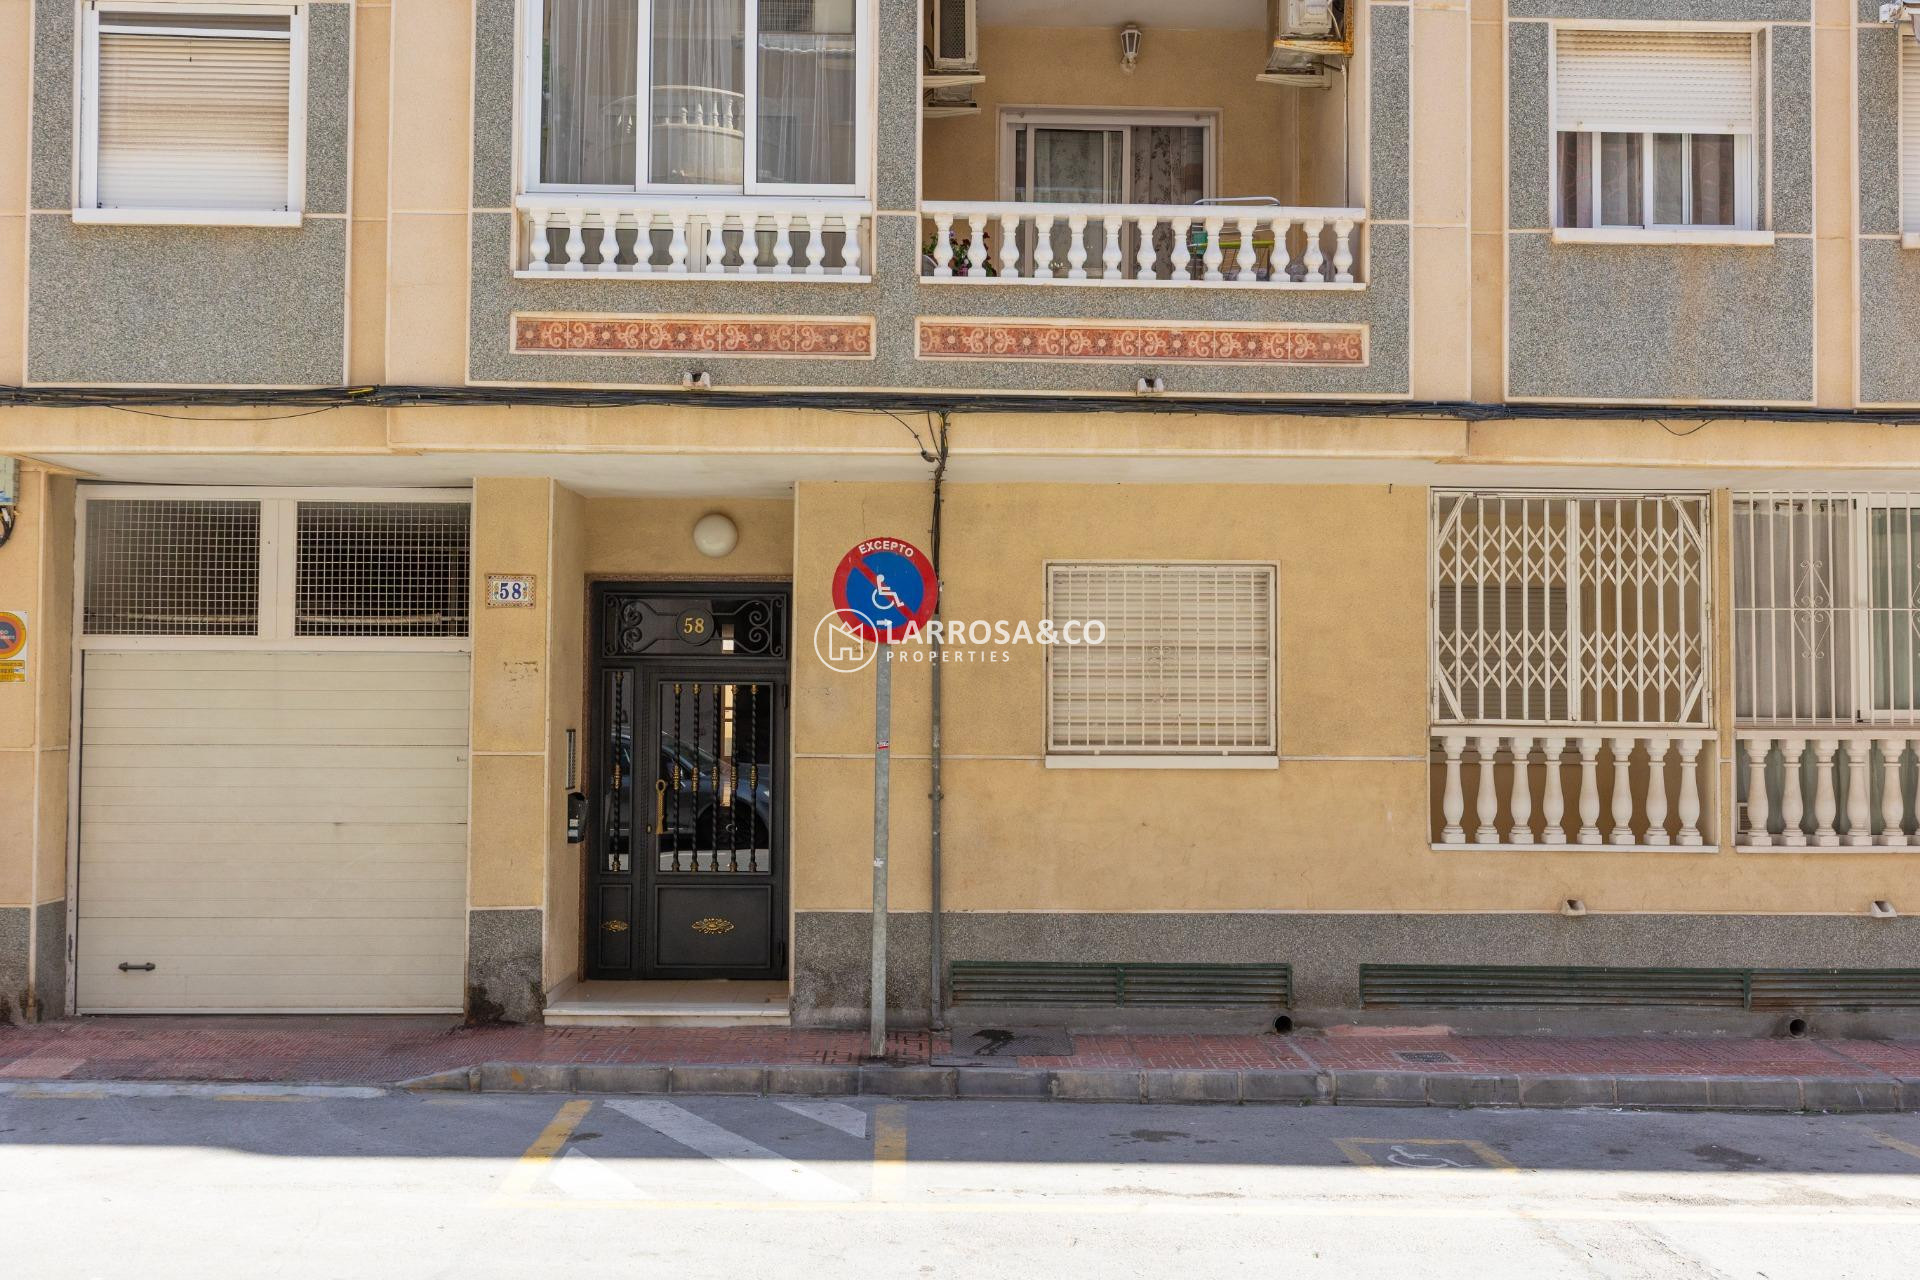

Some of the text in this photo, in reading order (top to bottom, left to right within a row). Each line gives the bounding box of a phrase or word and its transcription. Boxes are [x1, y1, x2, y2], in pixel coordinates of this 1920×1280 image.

[858, 540, 914, 558] EXCEPTO
[499, 582, 522, 600] 58
[683, 617, 705, 634] 58
